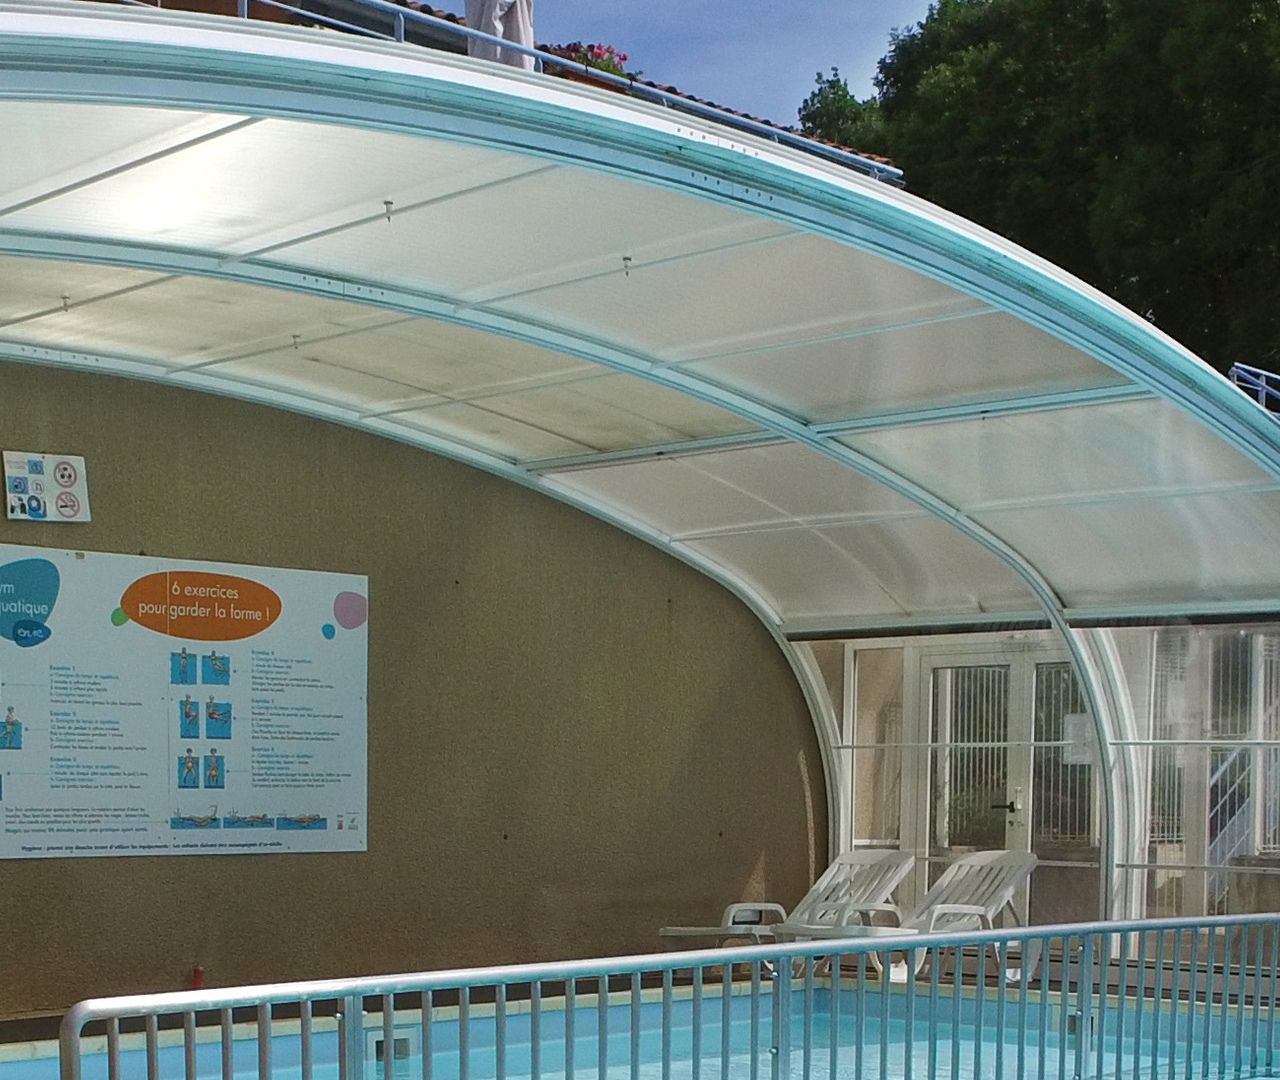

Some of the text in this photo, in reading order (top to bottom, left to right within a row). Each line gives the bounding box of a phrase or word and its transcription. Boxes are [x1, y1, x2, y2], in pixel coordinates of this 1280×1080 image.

[184, 584, 240, 600] exercices
[138, 602, 167, 617] pour
[169, 601, 211, 620] garder
[215, 602, 226, 618] la
[230, 603, 262, 621] forme
